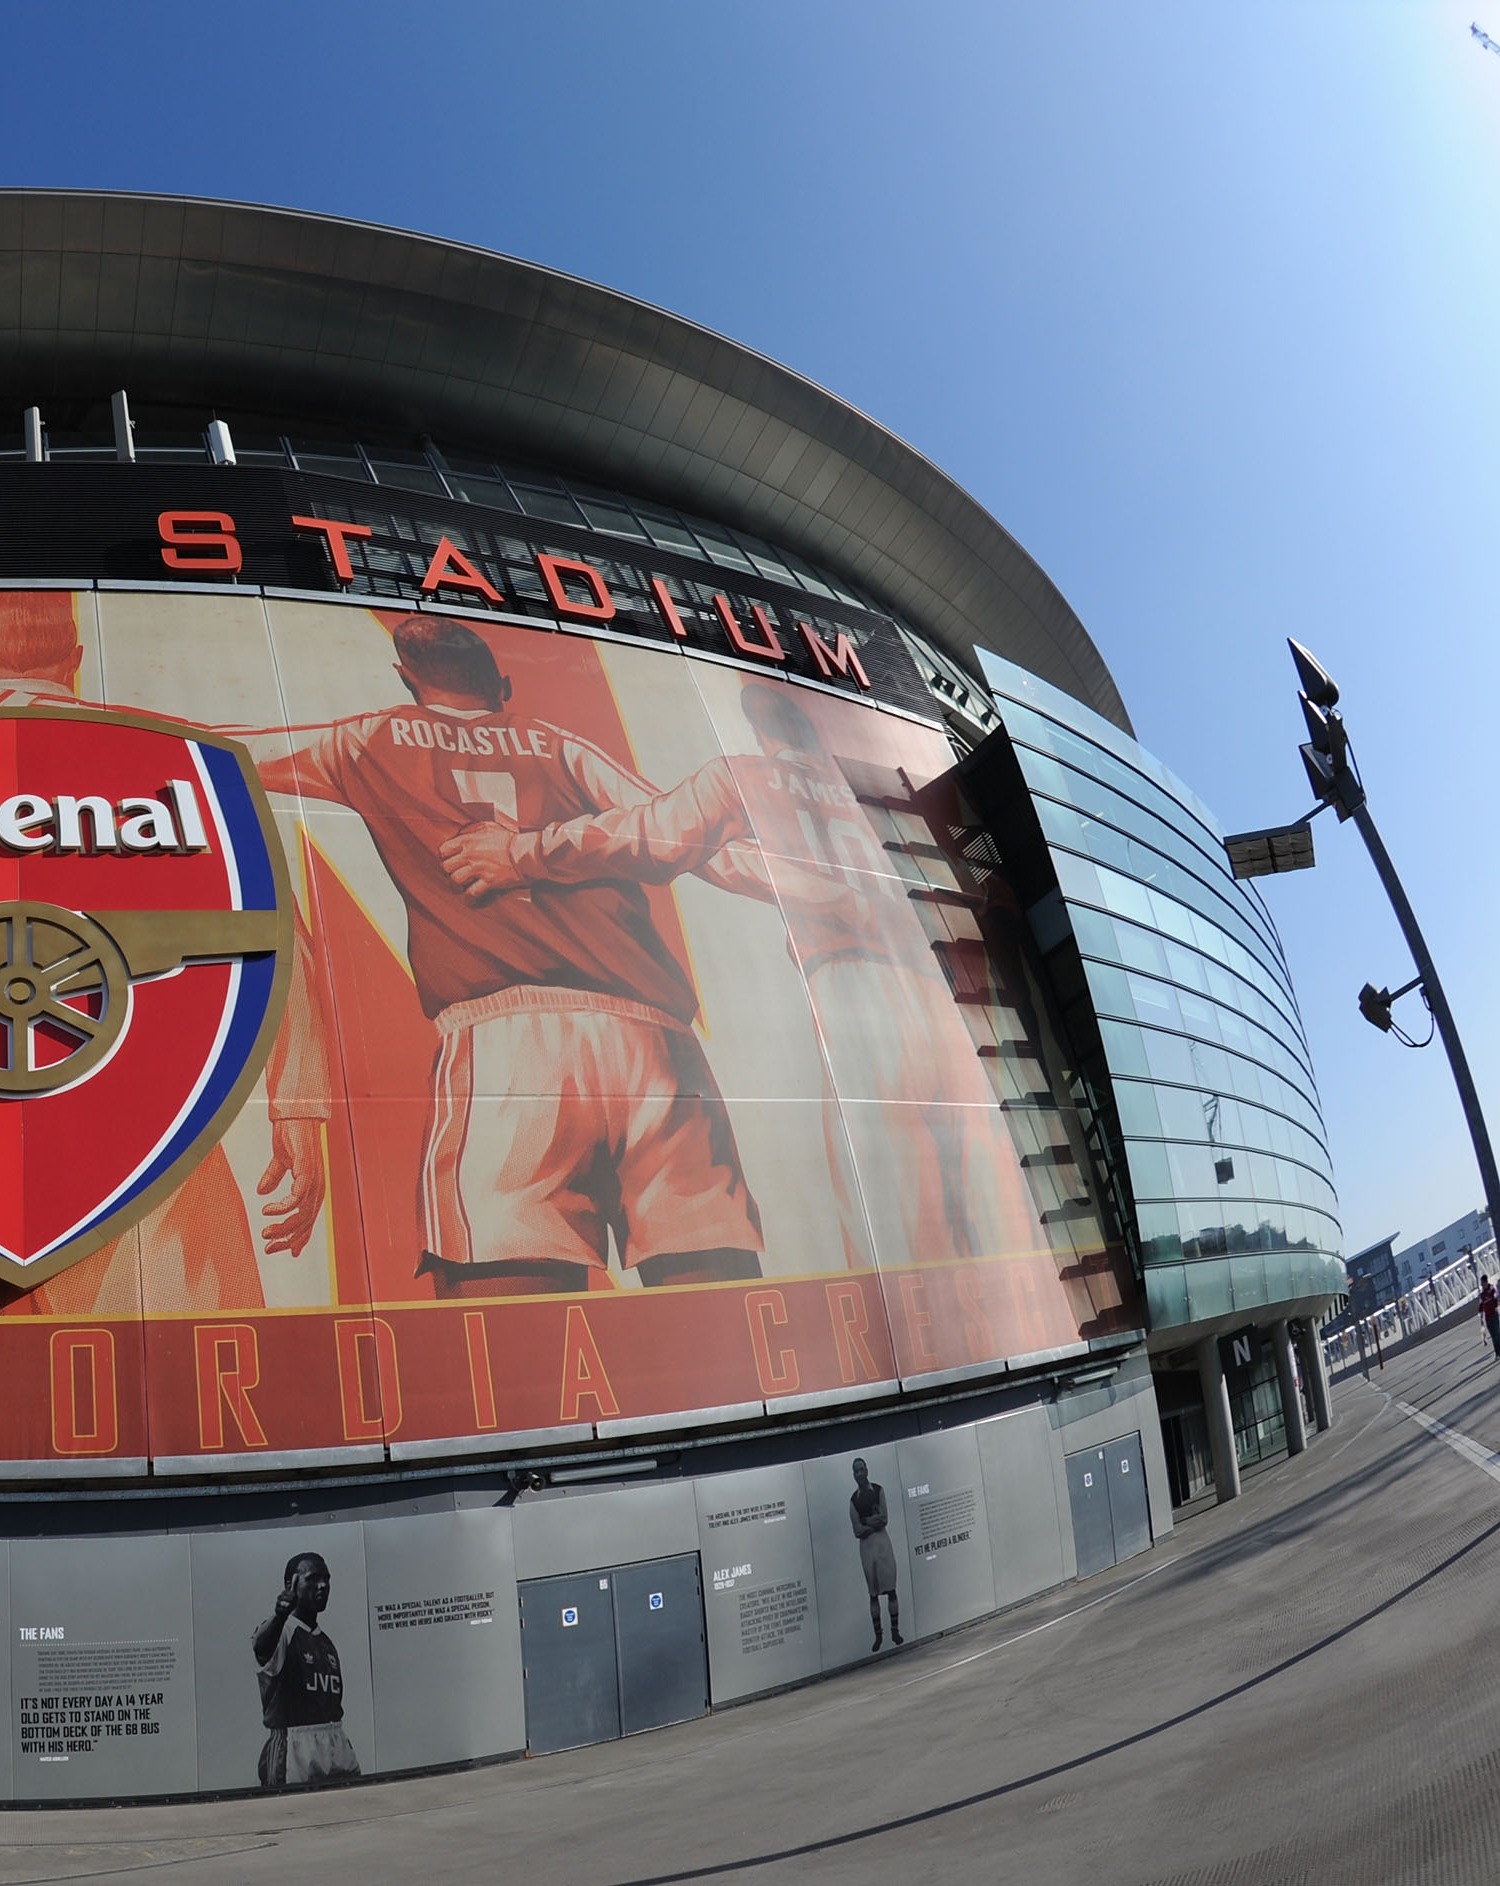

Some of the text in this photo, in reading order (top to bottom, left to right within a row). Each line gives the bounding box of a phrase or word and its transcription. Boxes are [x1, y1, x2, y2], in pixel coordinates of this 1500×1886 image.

[157, 510, 871, 691] STADIUM
[390, 718, 552, 759] ROCASTLE
[768, 767, 862, 808] JAMES
[1232, 1335, 1252, 1366] N
[713, 1563, 752, 1582] ALEX JAMES
[19, 1627, 64, 1641] THE FANS
[306, 1671, 341, 1694] JVC
[20, 1693, 164, 1710] IT'S NOT EVERY DAY A 14 YEAR
[21, 1708, 151, 1724] OLD GETS TO STAND ON THE
[21, 1722, 160, 1739] BOTTOM DECK OF THE 68 BUS
[21, 1740, 45, 1753] WITH
[48, 1740, 64, 1753] HIS
